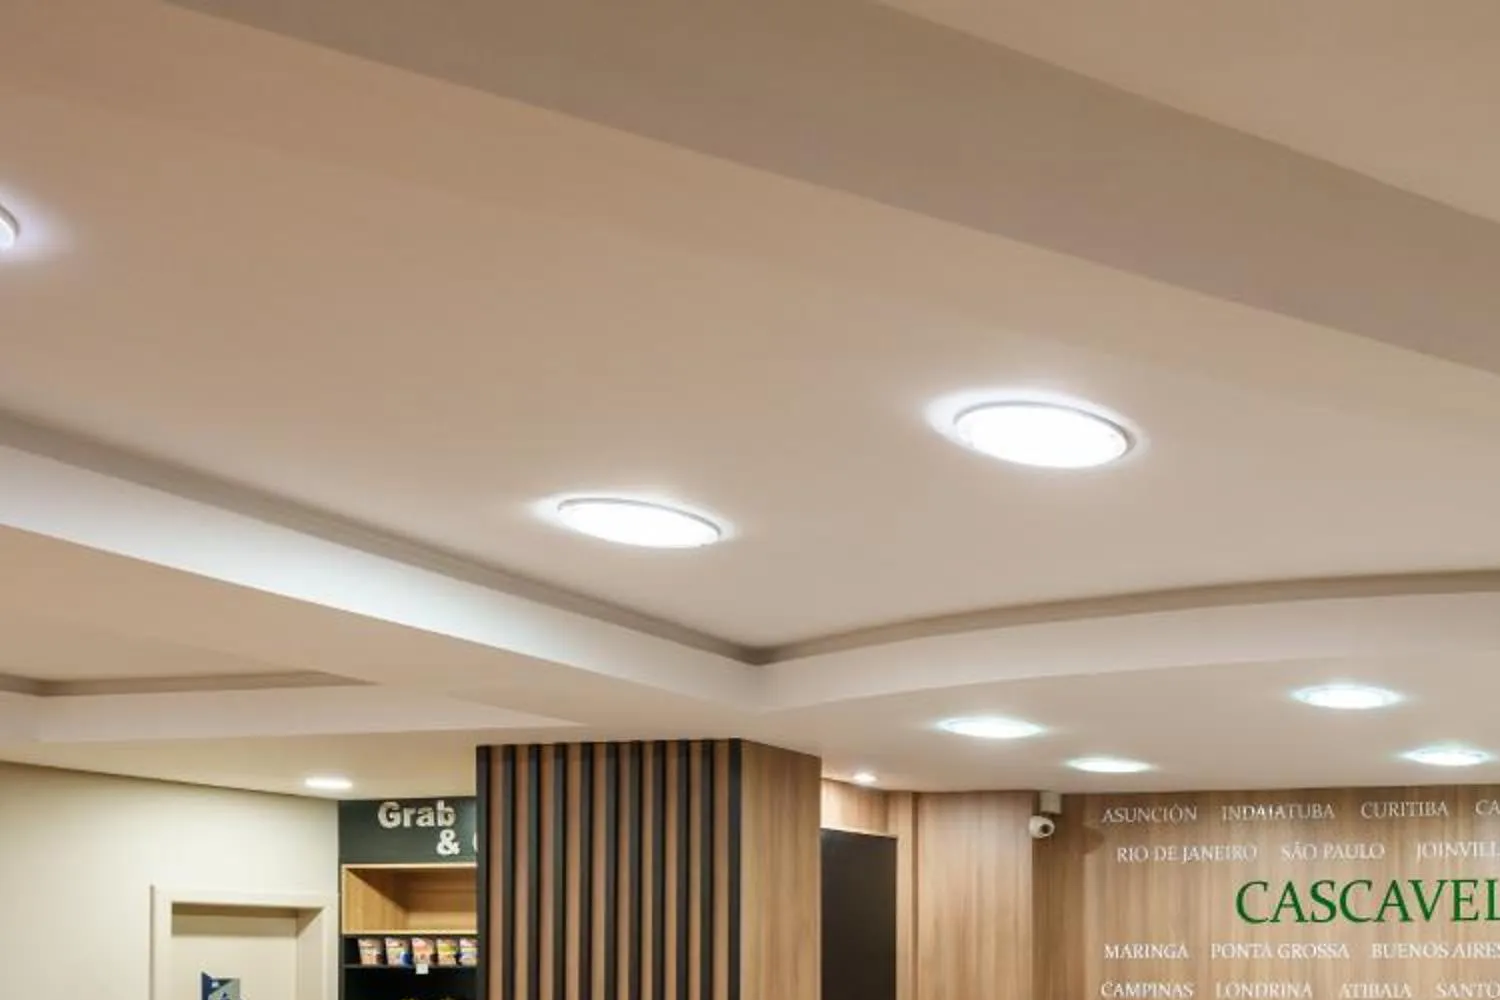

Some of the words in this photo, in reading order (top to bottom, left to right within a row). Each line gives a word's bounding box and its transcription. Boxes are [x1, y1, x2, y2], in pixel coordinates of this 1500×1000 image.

[378, 800, 456, 828] Grab
[1102, 804, 1197, 824] ASUNCIÓN
[1222, 804, 1336, 822] INDAIATUBA
[1361, 800, 1449, 818] CURITIBA
[437, 829, 460, 855] &
[1116, 847, 1149, 863] RIO
[1154, 846, 1177, 861] DE
[1181, 845, 1258, 864] JANEIRO
[1281, 842, 1317, 860] SÃO
[1323, 843, 1385, 859] PAULO
[1211, 943, 1273, 960] PONTA
[1278, 943, 1350, 960] GROSSA
[1371, 943, 1449, 960] BUENOS
[1101, 980, 1194, 998] CAMPINAS
[1216, 982, 1313, 998] LONDRINA
[1339, 983, 1412, 998] ATIBAIA
